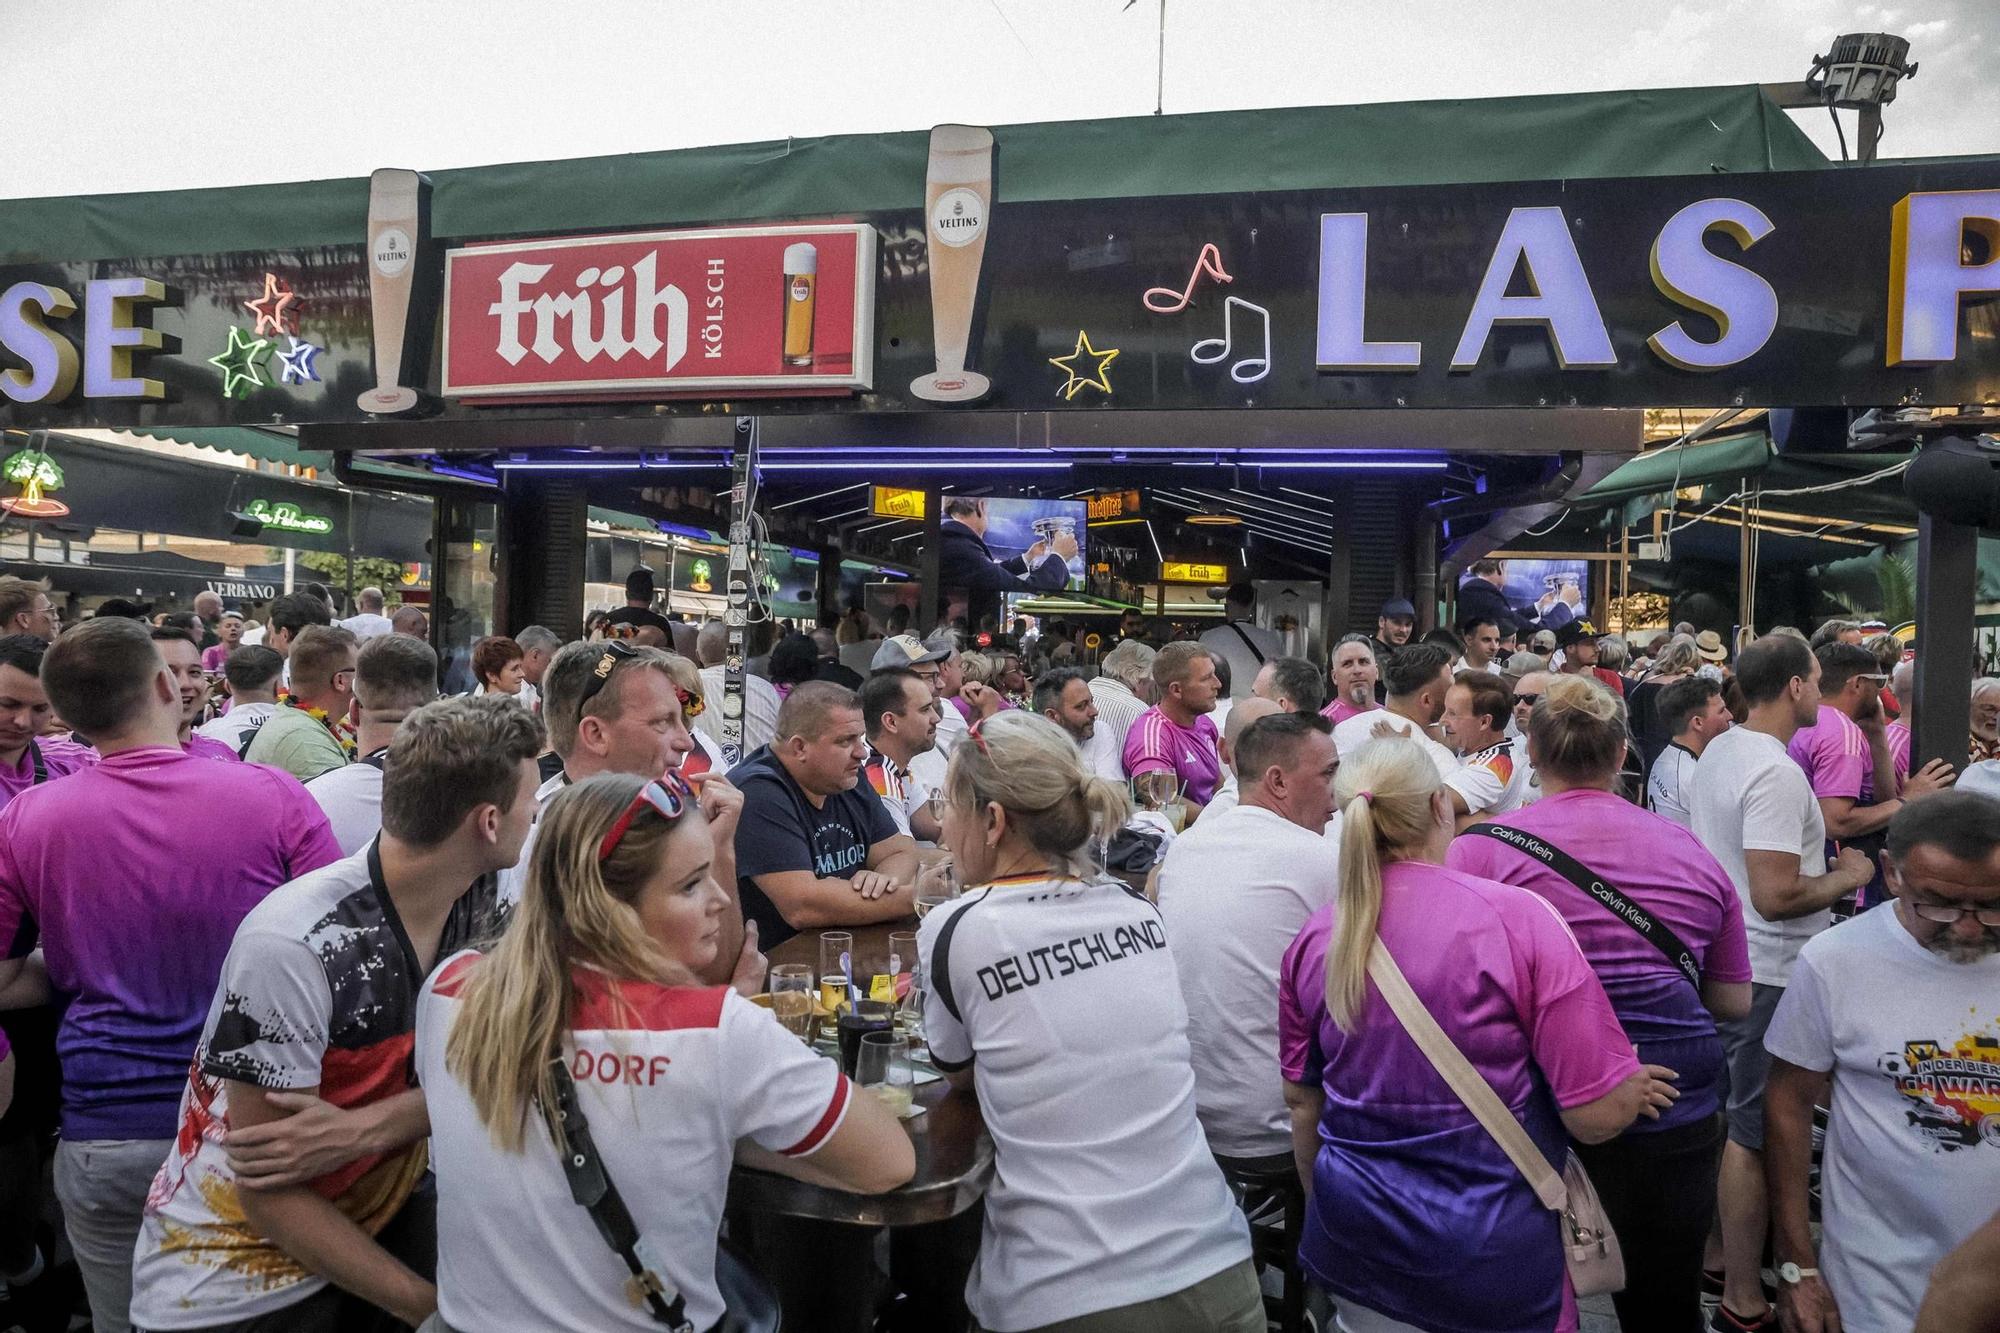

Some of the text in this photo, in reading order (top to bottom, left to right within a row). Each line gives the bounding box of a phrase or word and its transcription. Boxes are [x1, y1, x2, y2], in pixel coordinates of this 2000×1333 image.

[378, 251, 407, 261] VELTINS
[940, 217, 978, 229] VELTINS
[487, 249, 688, 372] früh
[701, 259, 725, 359] KÖLSCH
[1315, 198, 1779, 371] LAS
[0, 277, 165, 403] SE
[1491, 826, 1554, 862] Calvin Klein
[1591, 881, 1652, 933] Calvin Klein
[976, 919, 1167, 1001] DEUTSCHLAND
[1917, 1061, 1932, 1073] IN
[1936, 1060, 1962, 1071] DER
